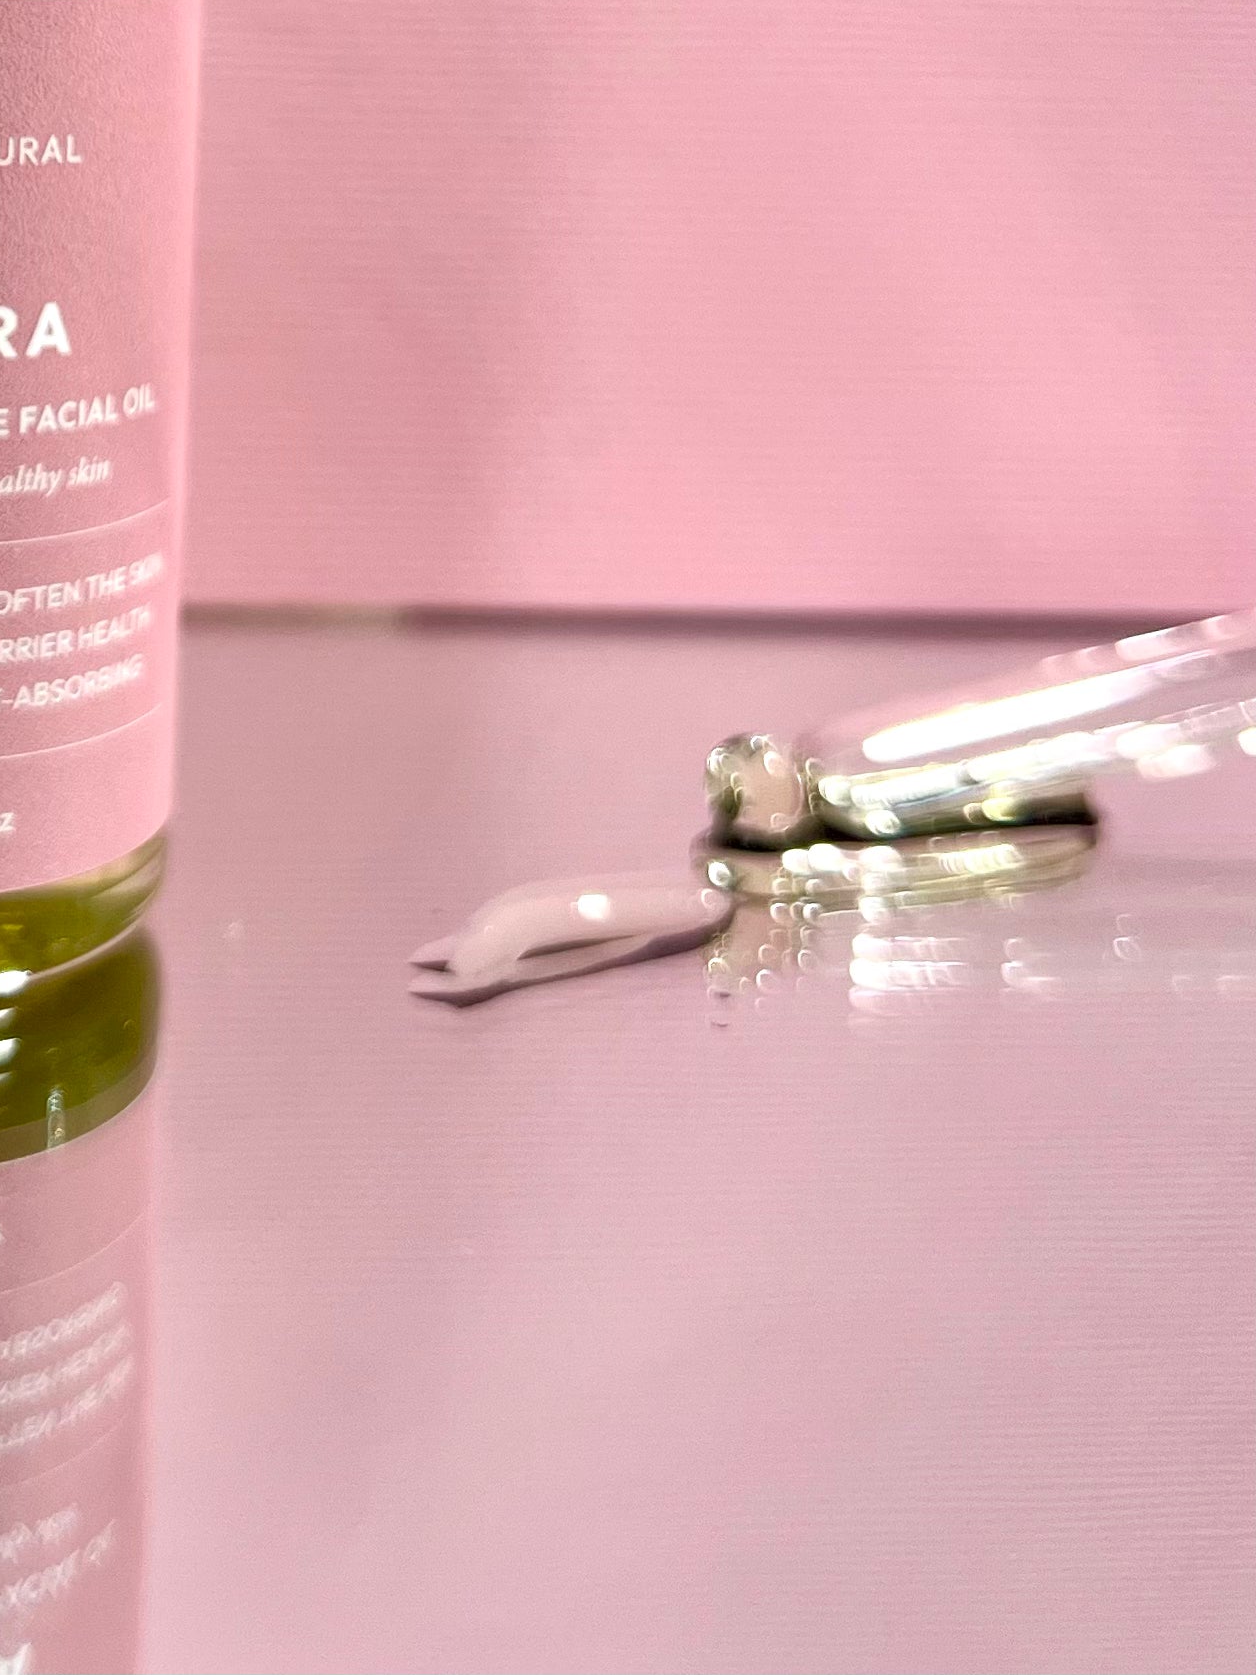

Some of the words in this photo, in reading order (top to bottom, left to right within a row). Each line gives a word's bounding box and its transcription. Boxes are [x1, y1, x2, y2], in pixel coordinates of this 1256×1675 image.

[18, 392, 118, 434] FACIAL
[123, 383, 155, 418] OIL
[66, 454, 112, 486] skin
[85, 565, 127, 600] THE
[77, 603, 152, 651] HEALTH
